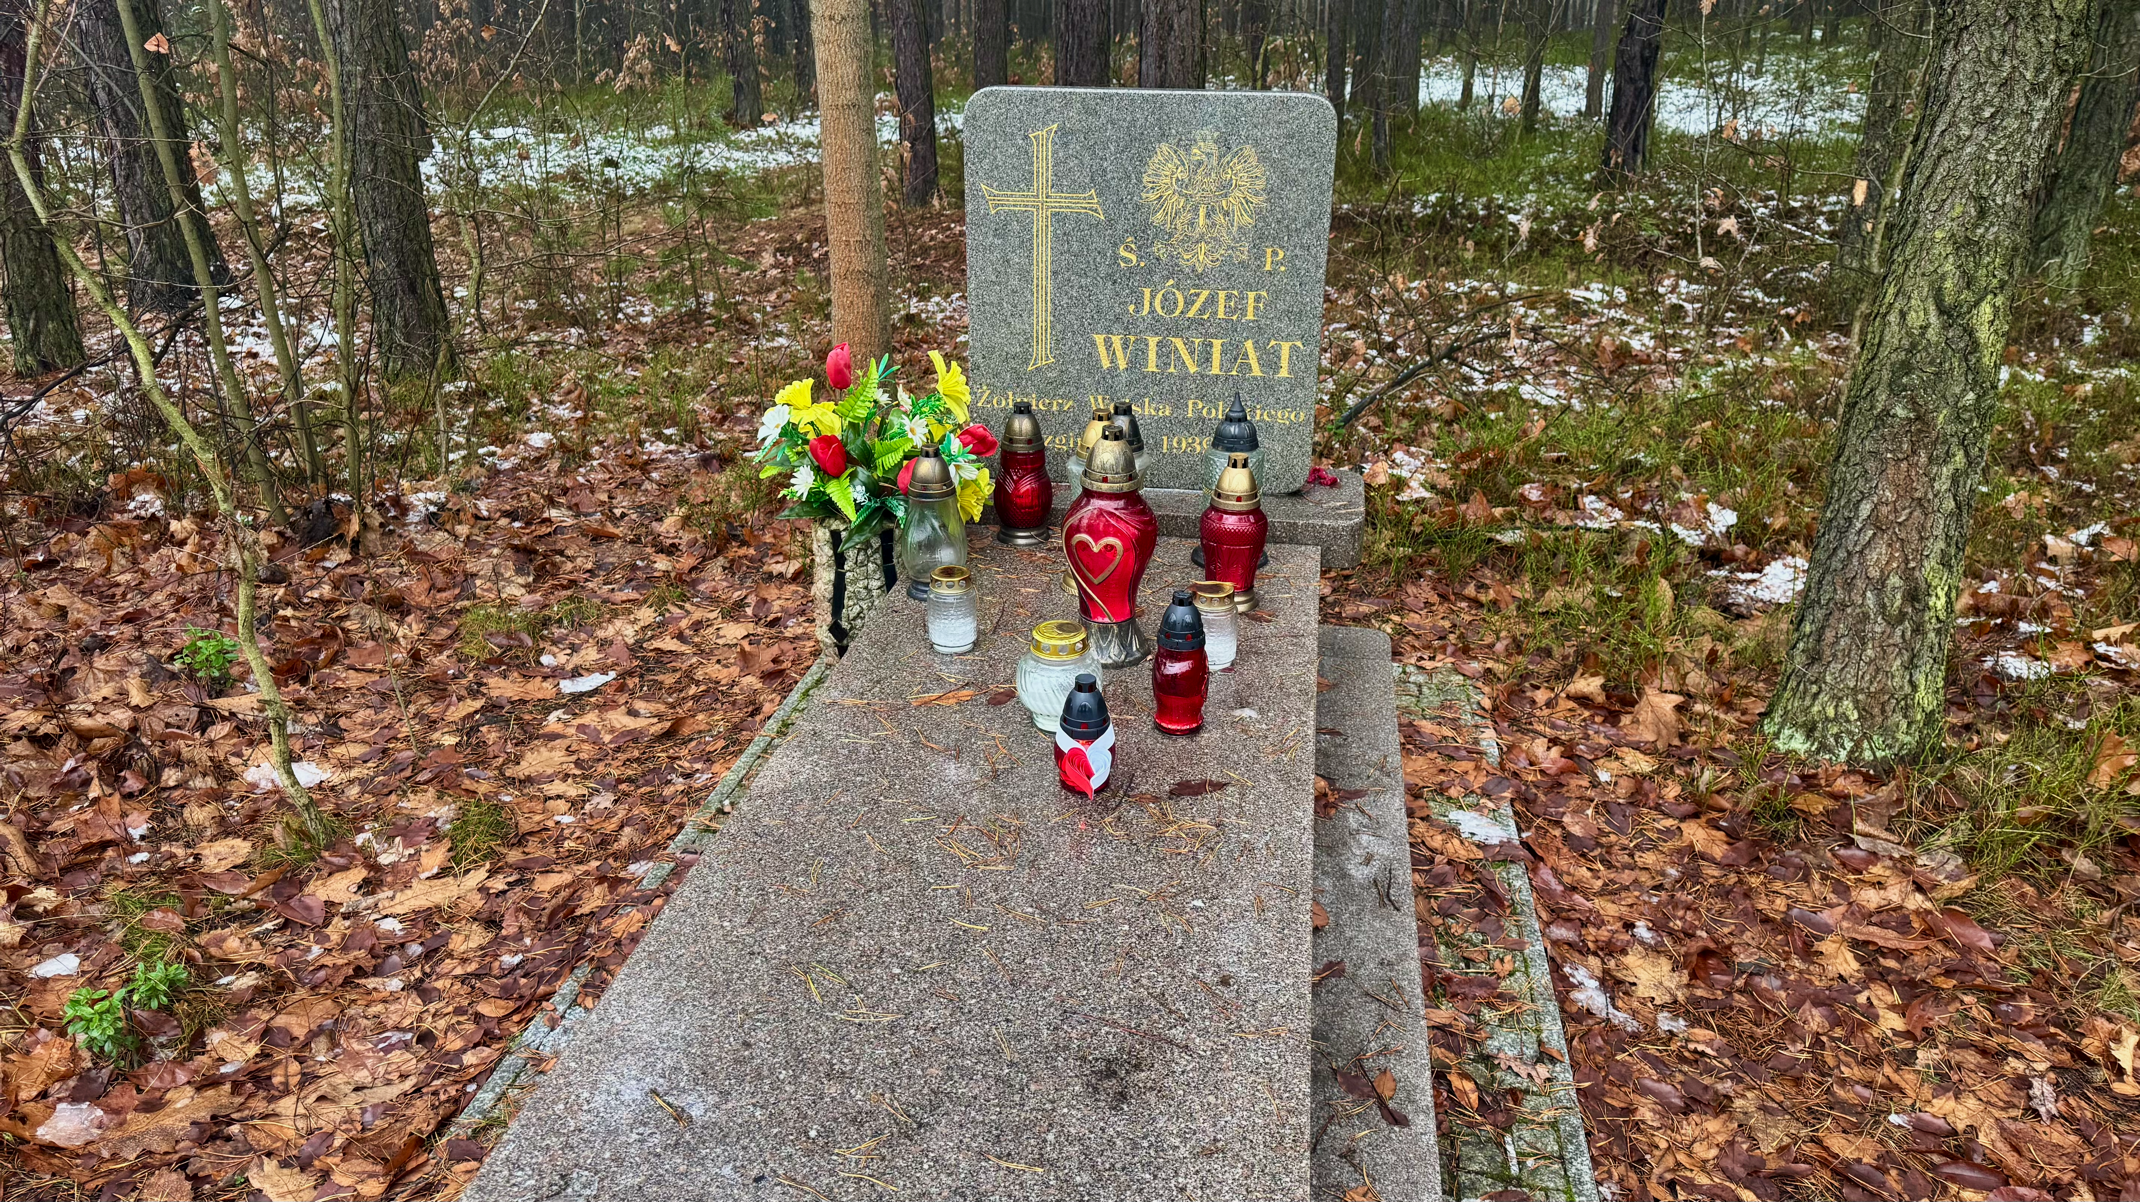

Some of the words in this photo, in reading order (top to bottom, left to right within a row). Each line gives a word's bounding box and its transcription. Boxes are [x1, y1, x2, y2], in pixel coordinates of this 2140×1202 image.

[1118, 236, 1146, 268] Ś.
[1264, 247, 1286, 272] P.
[1128, 278, 1269, 321] JÓZEF
[1092, 333, 1304, 378] WINIAT
